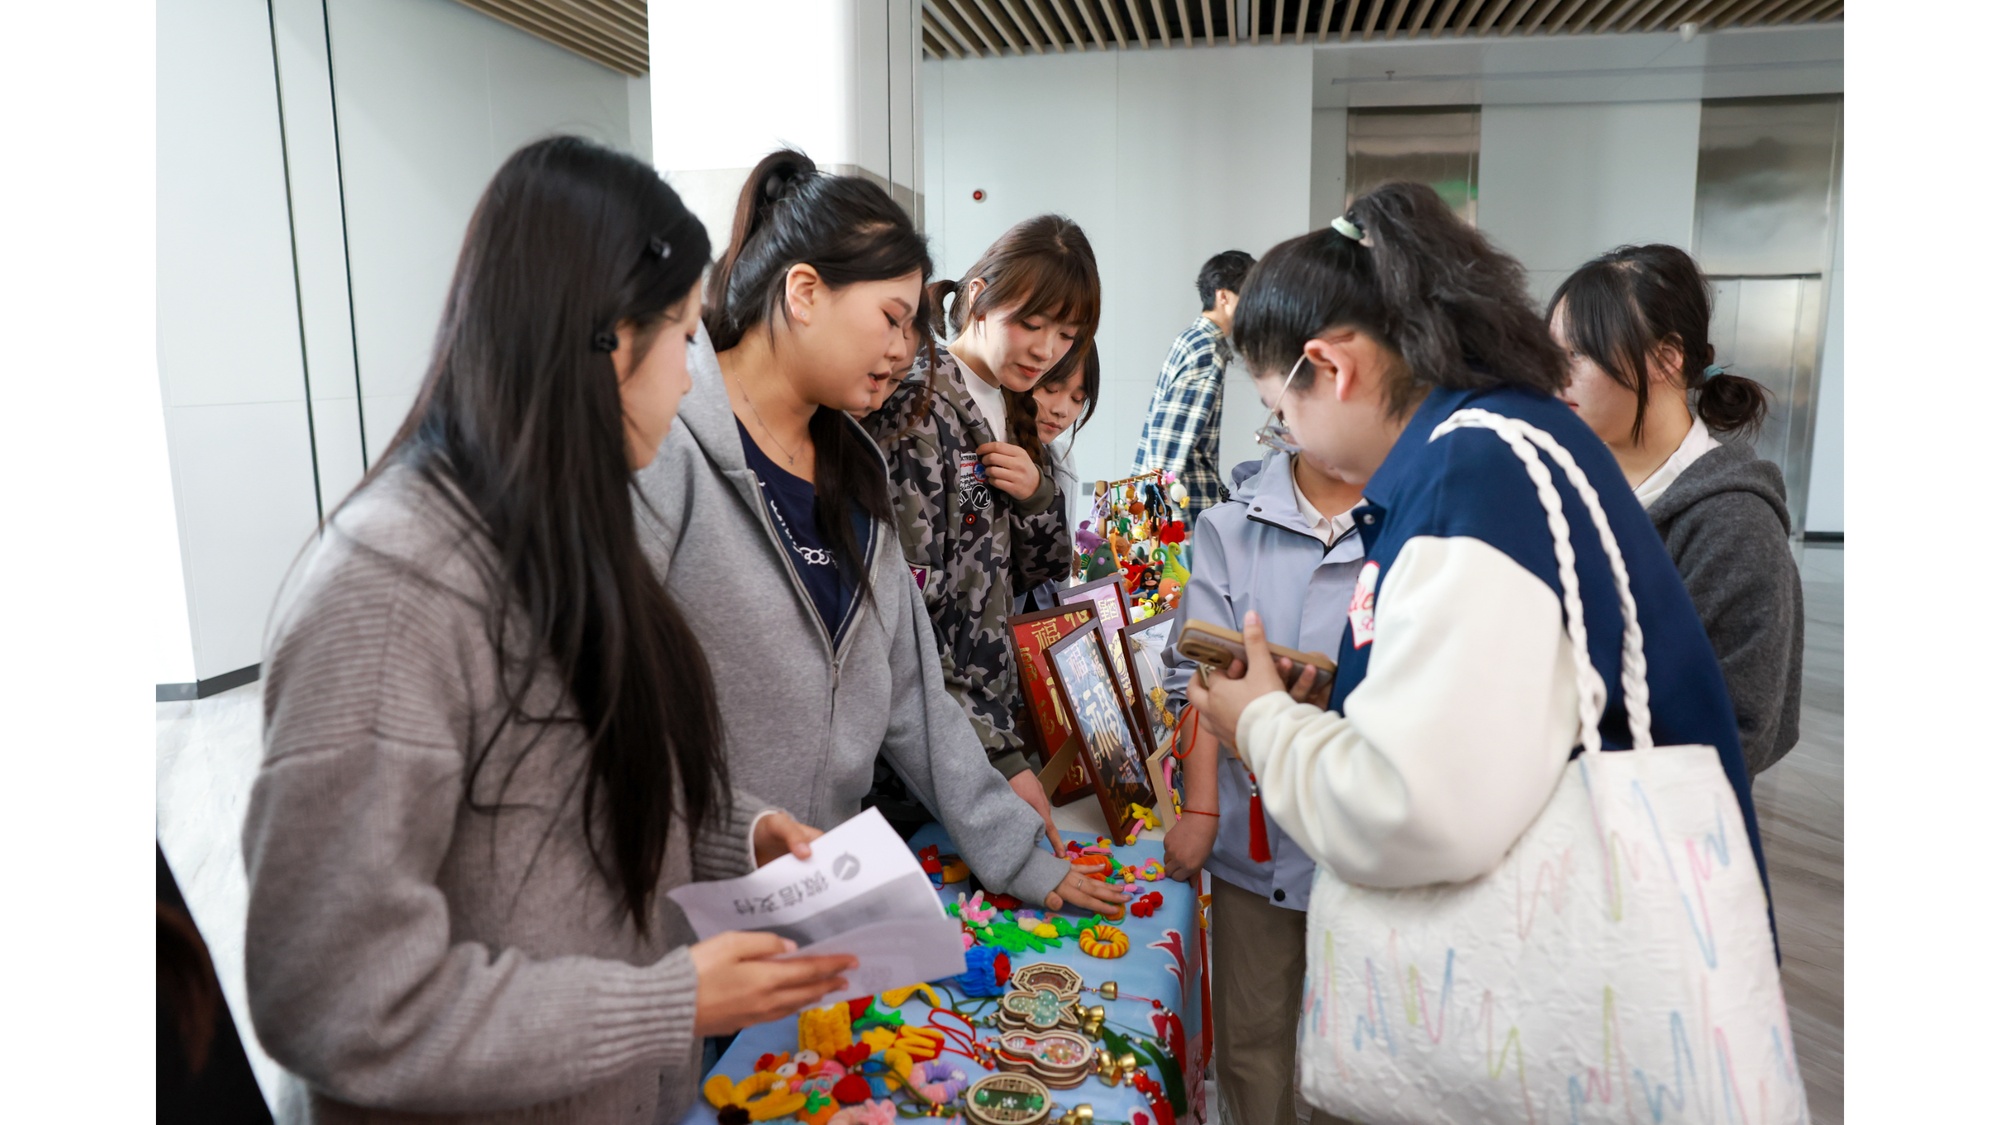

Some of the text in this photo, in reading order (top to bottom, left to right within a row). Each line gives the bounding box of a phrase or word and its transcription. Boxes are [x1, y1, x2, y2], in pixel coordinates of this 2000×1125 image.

[1031, 618, 1061, 656] 福
[1063, 640, 1089, 683] 福
[1085, 682, 1122, 760] 福
[733, 870, 829, 915] 微信支付
